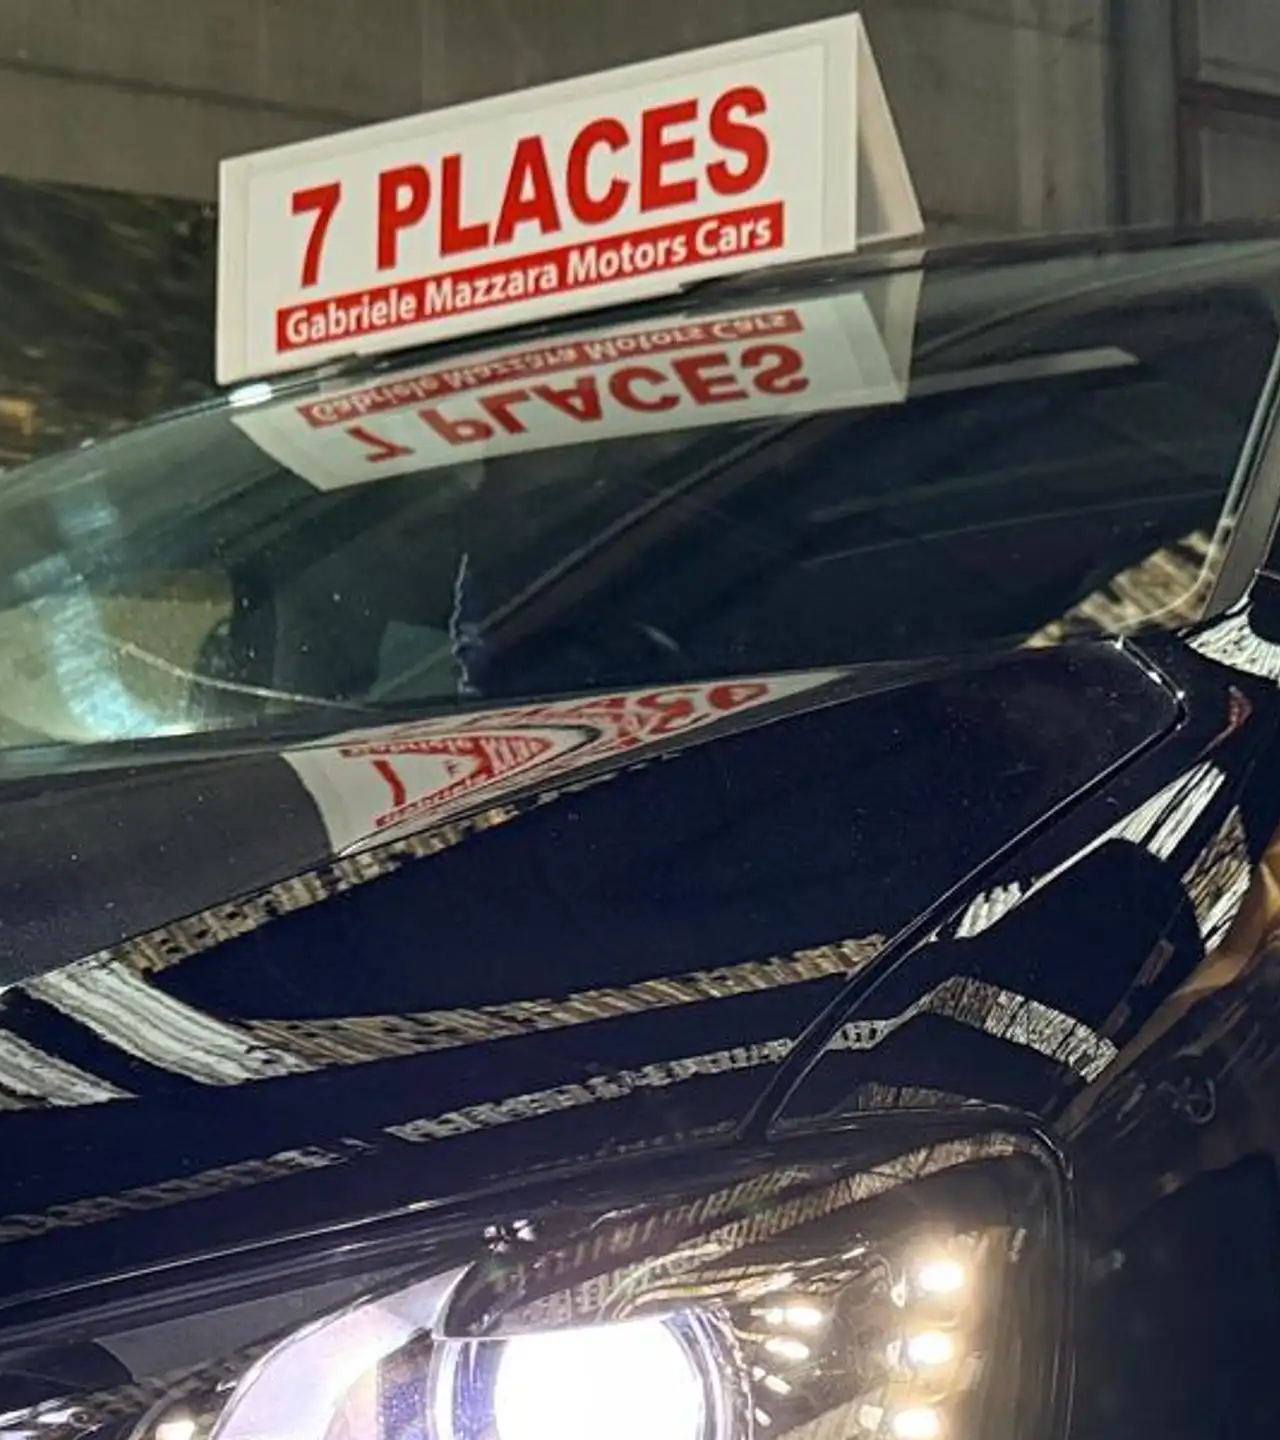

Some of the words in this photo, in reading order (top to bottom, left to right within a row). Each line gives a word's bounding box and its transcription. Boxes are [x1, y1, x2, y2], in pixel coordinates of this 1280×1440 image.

[291, 183, 341, 289] 7
[376, 86, 770, 270] PLACES
[286, 295, 417, 345] Gabriele
[424, 264, 558, 314] Mazzara
[567, 235, 687, 281] Motors
[695, 213, 772, 255] Cars
